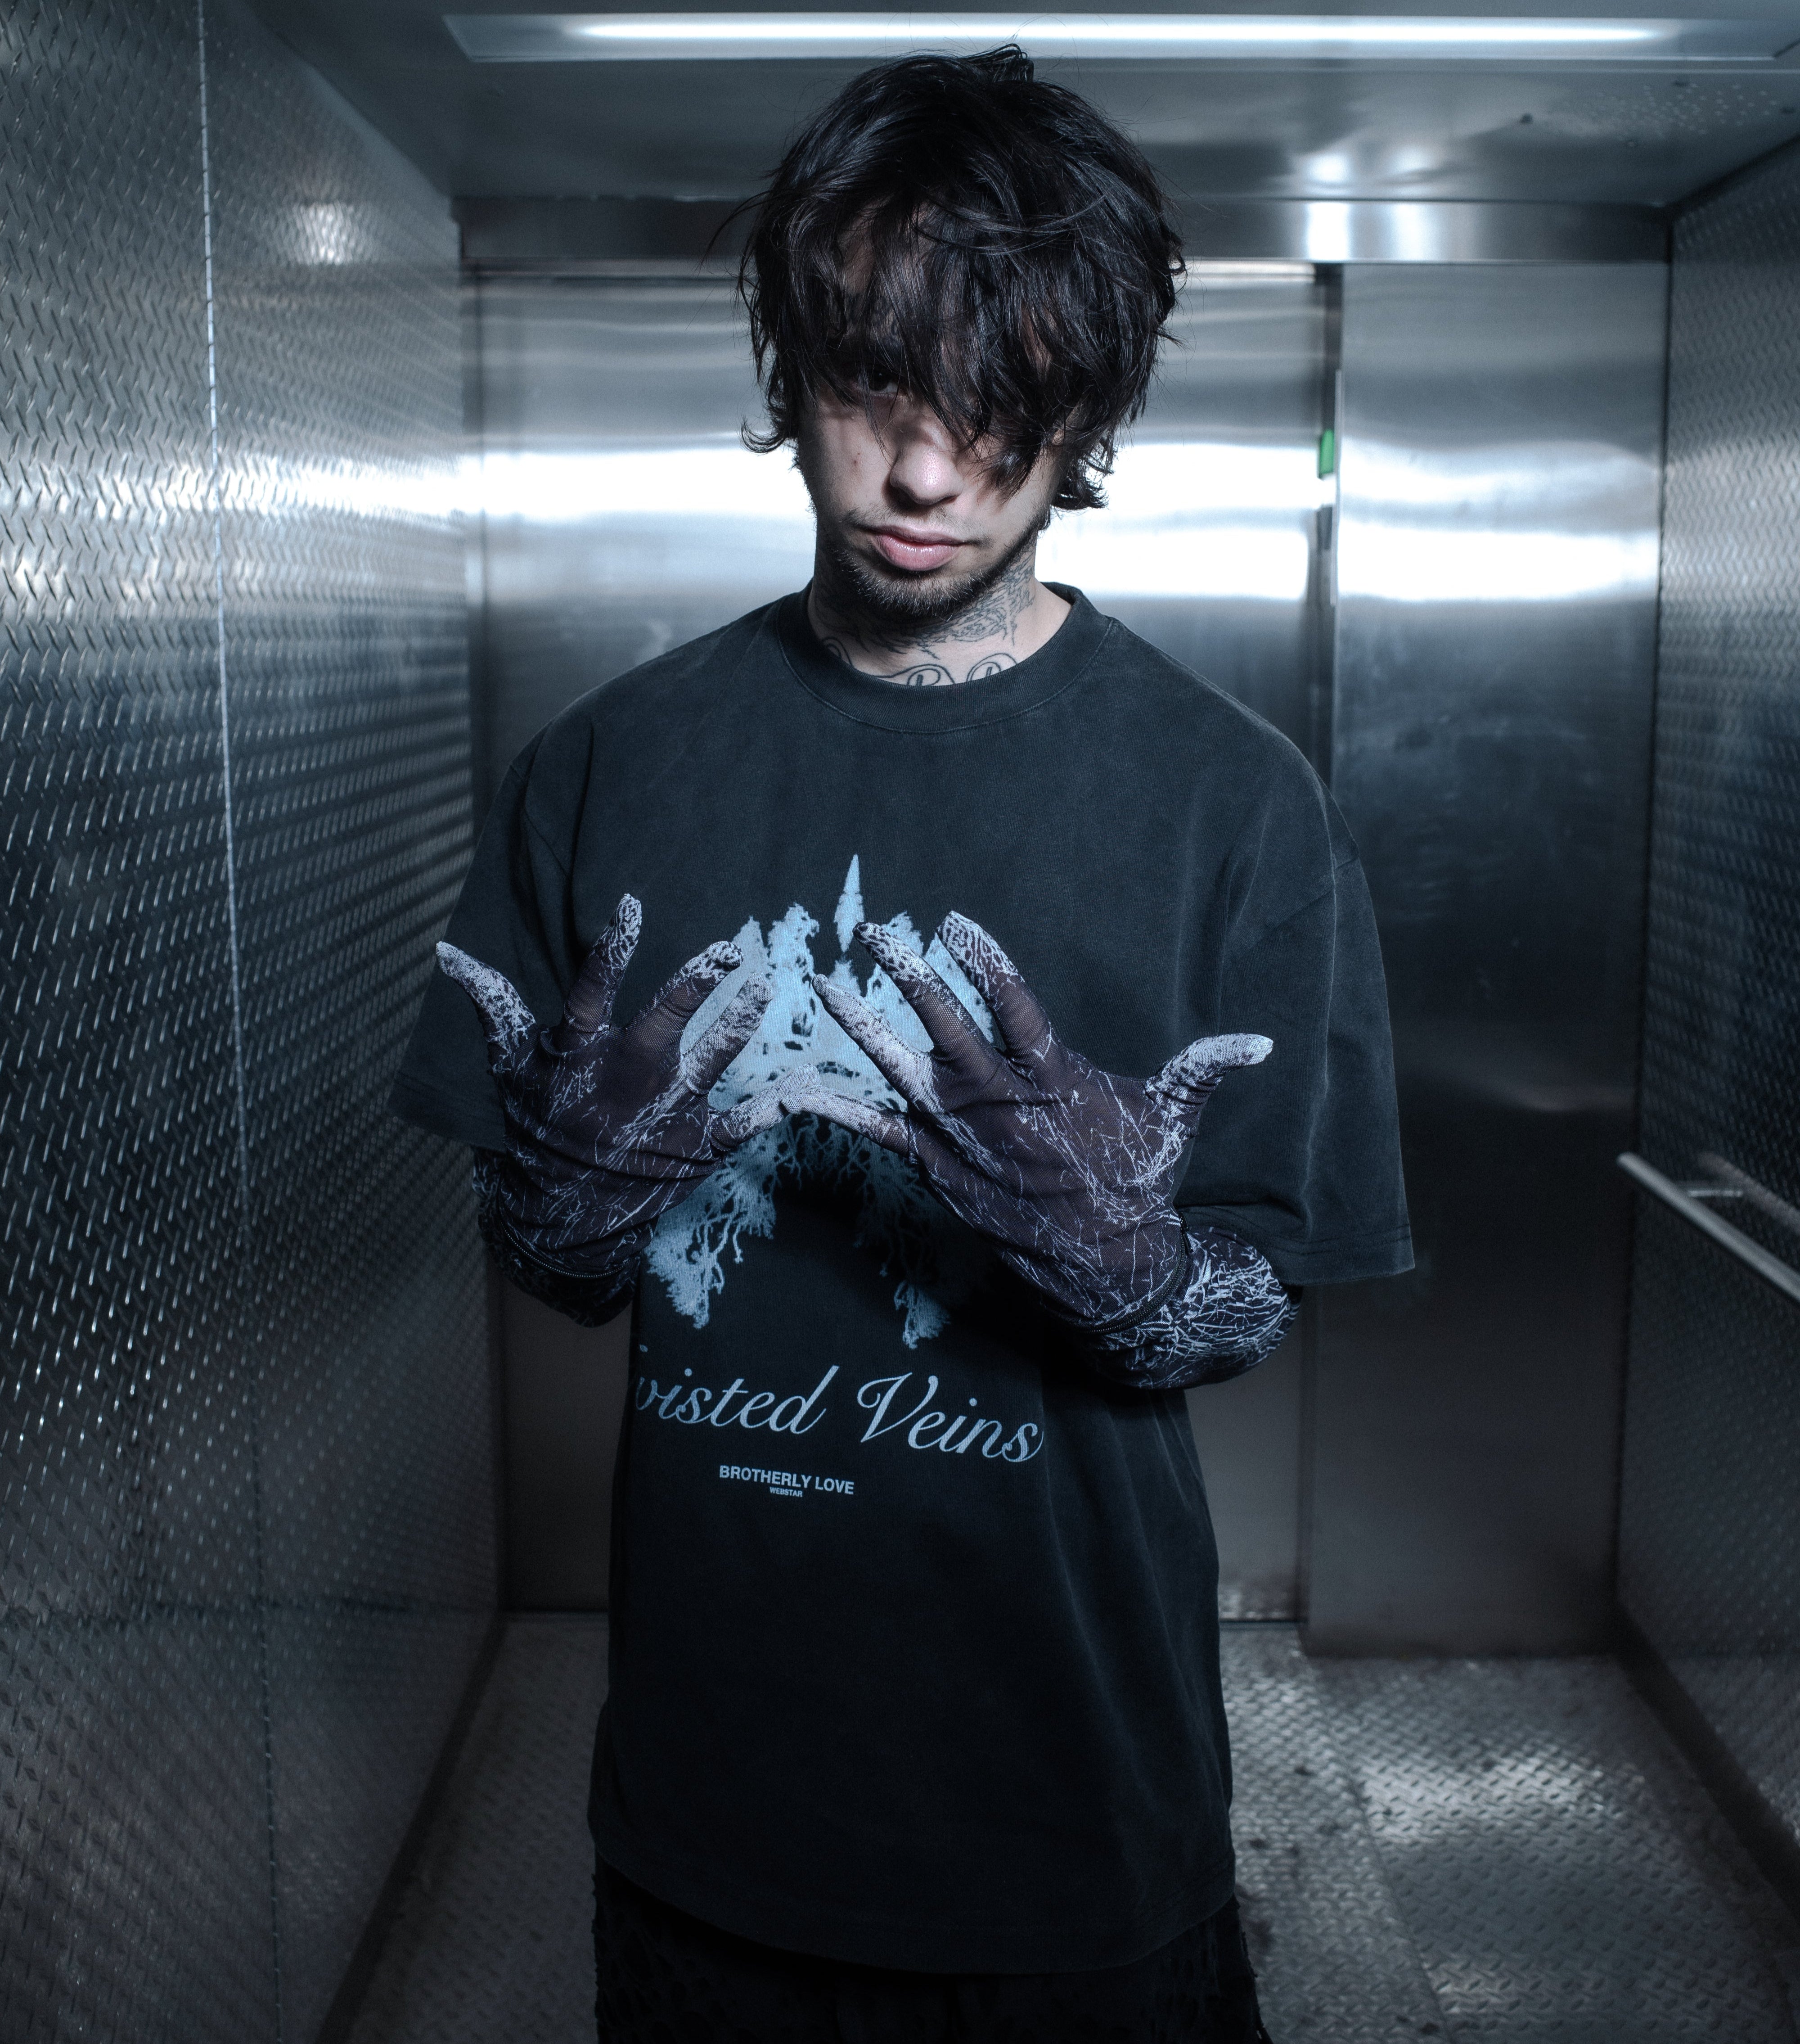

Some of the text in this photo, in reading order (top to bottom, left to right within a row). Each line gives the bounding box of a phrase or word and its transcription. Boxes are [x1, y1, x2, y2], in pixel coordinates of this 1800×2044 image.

[857, 1372, 1044, 1462] Veins
[720, 1465, 854, 1495] BROTHERLY LOVE
[770, 1487, 803, 1498] WEBSTAR
